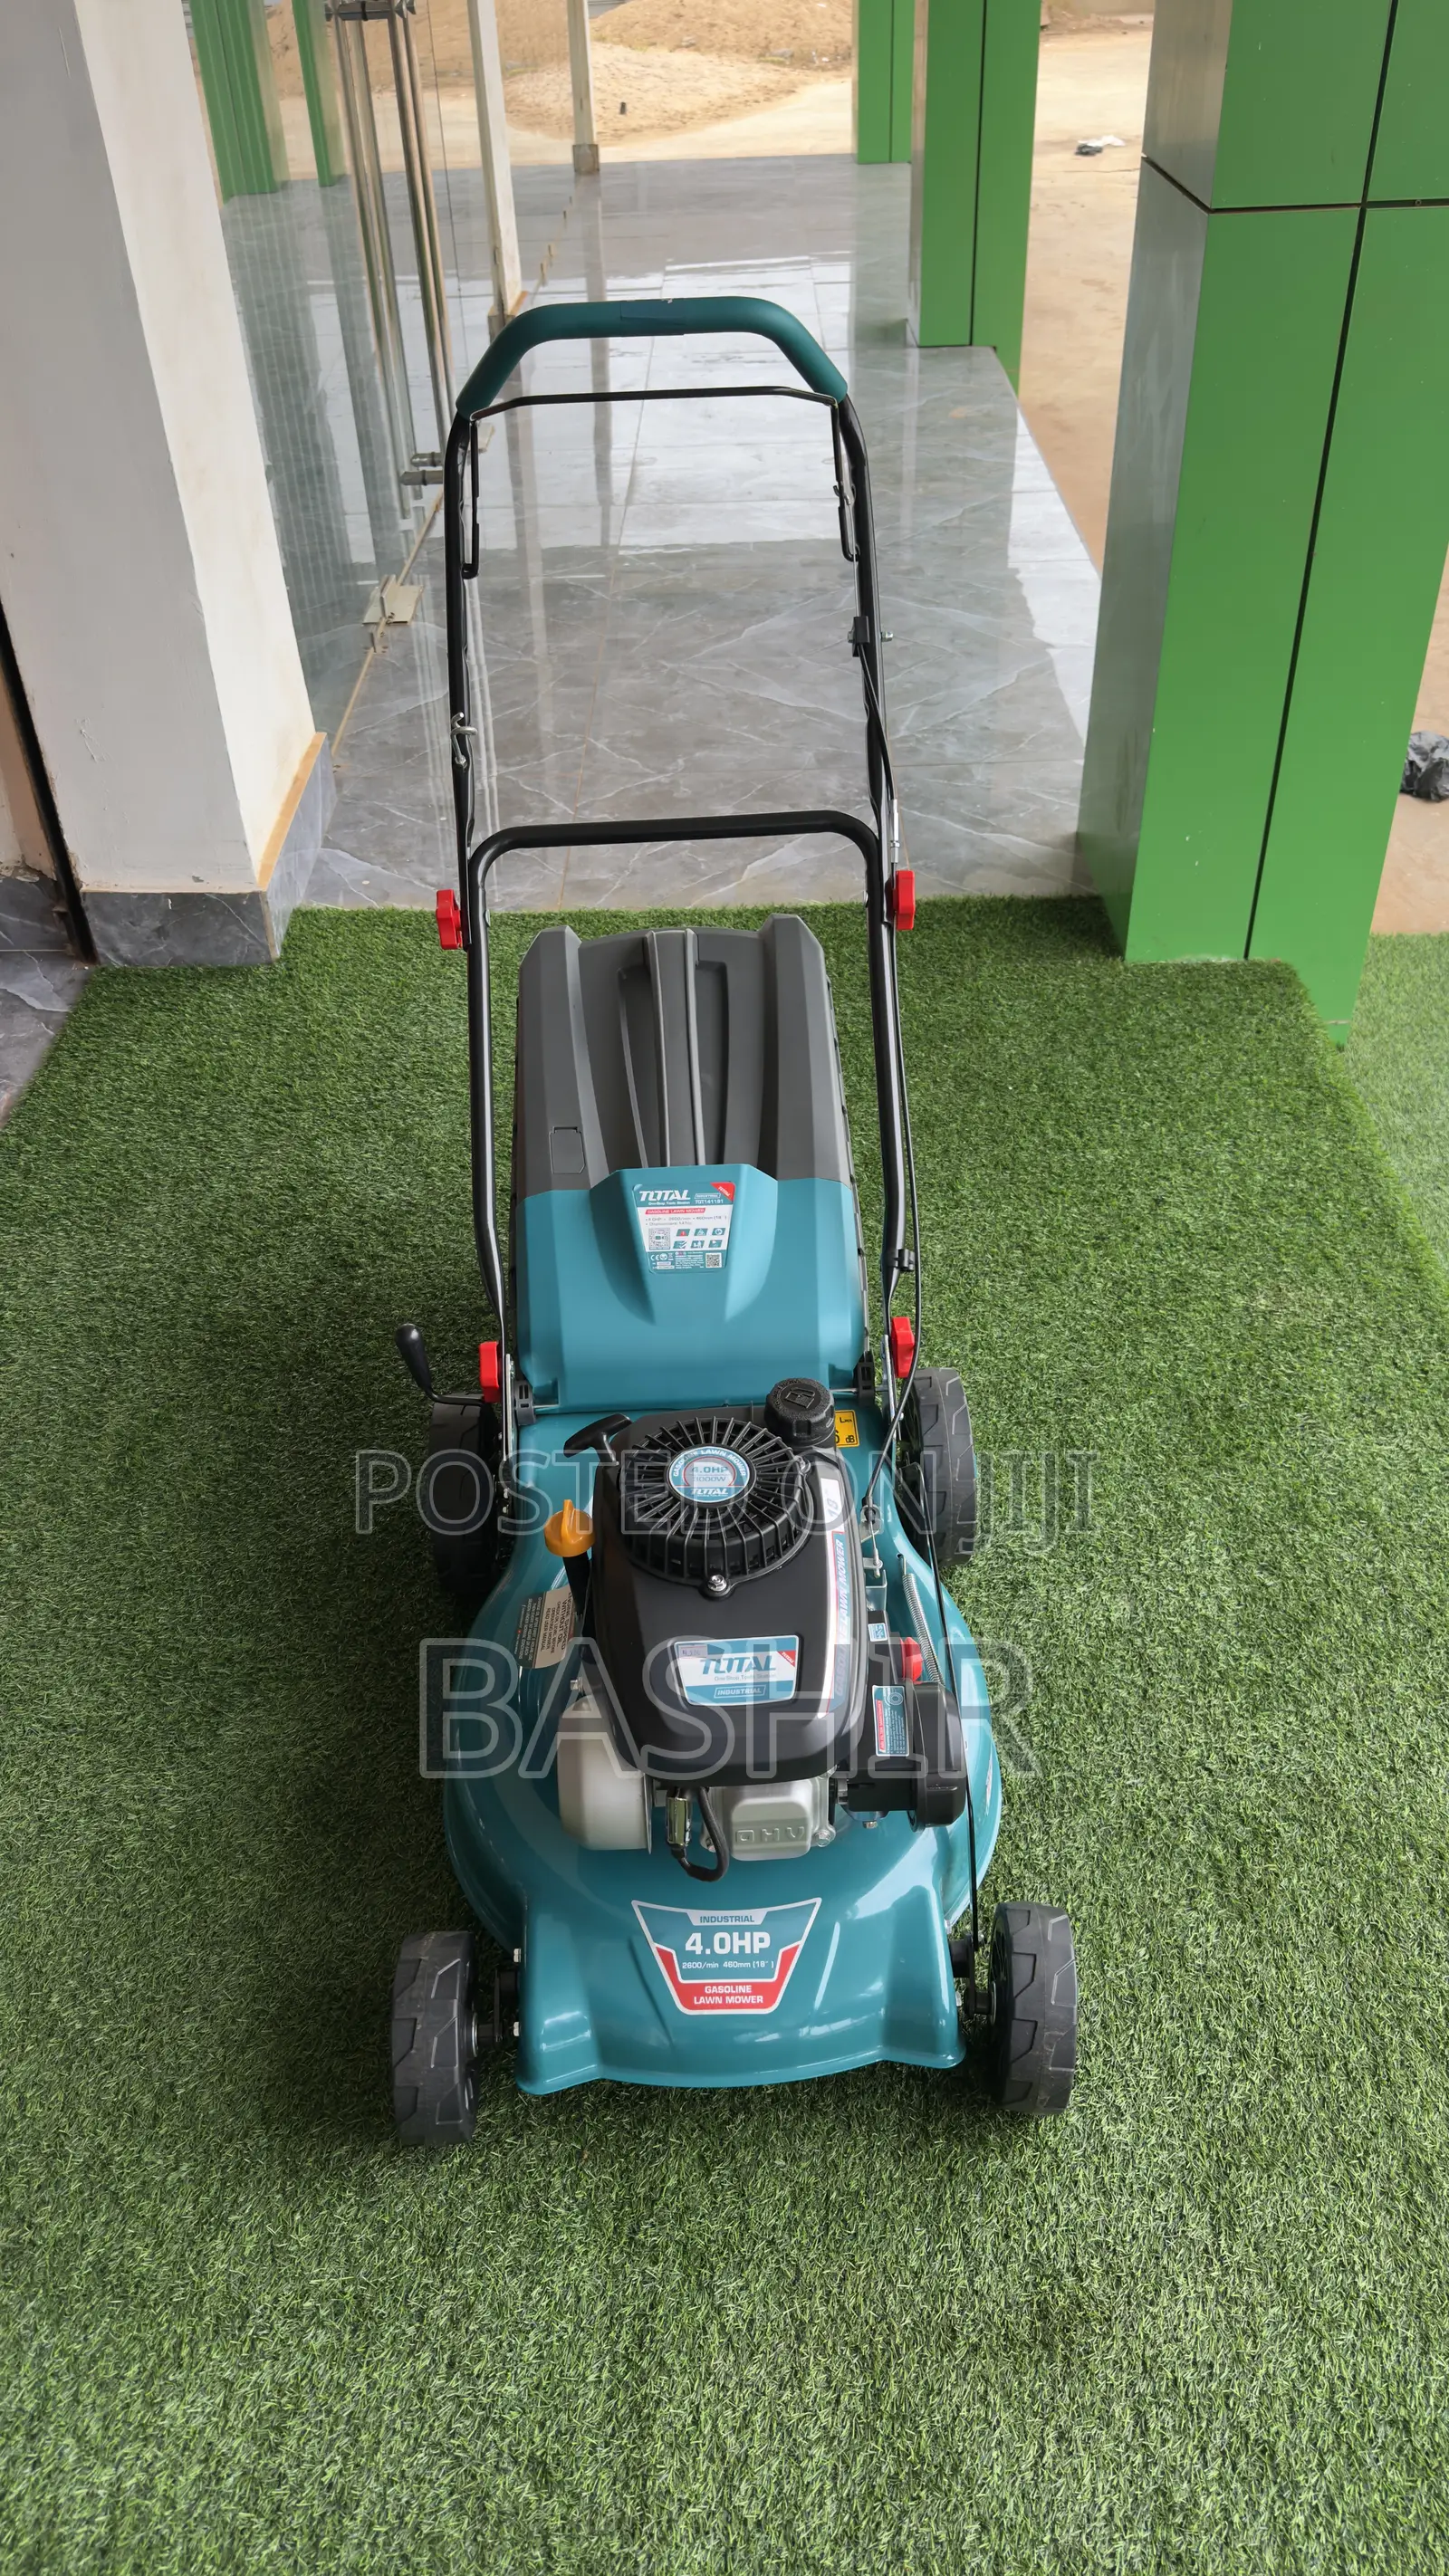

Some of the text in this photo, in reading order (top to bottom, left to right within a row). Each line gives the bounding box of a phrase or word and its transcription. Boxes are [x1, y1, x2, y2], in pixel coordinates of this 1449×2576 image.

[639, 1189, 691, 1202] TOTAL
[846, 1434, 856, 1442] dB
[701, 1449, 727, 1457] LAWN
[727, 1453, 747, 1477] MOWER
[835, 1538, 847, 1585] MOWER
[700, 1655, 777, 1675] TOTAL
[717, 1687, 763, 1696] INDUSTRIAL
[699, 1914, 755, 1923] INDUSTRIAL
[685, 1931, 771, 1955] 4.0HP
[682, 1961, 719, 1969] 2600/min
[705, 1985, 753, 1994] GASOLINE
[694, 1995, 764, 2005] LAWN MOWER
